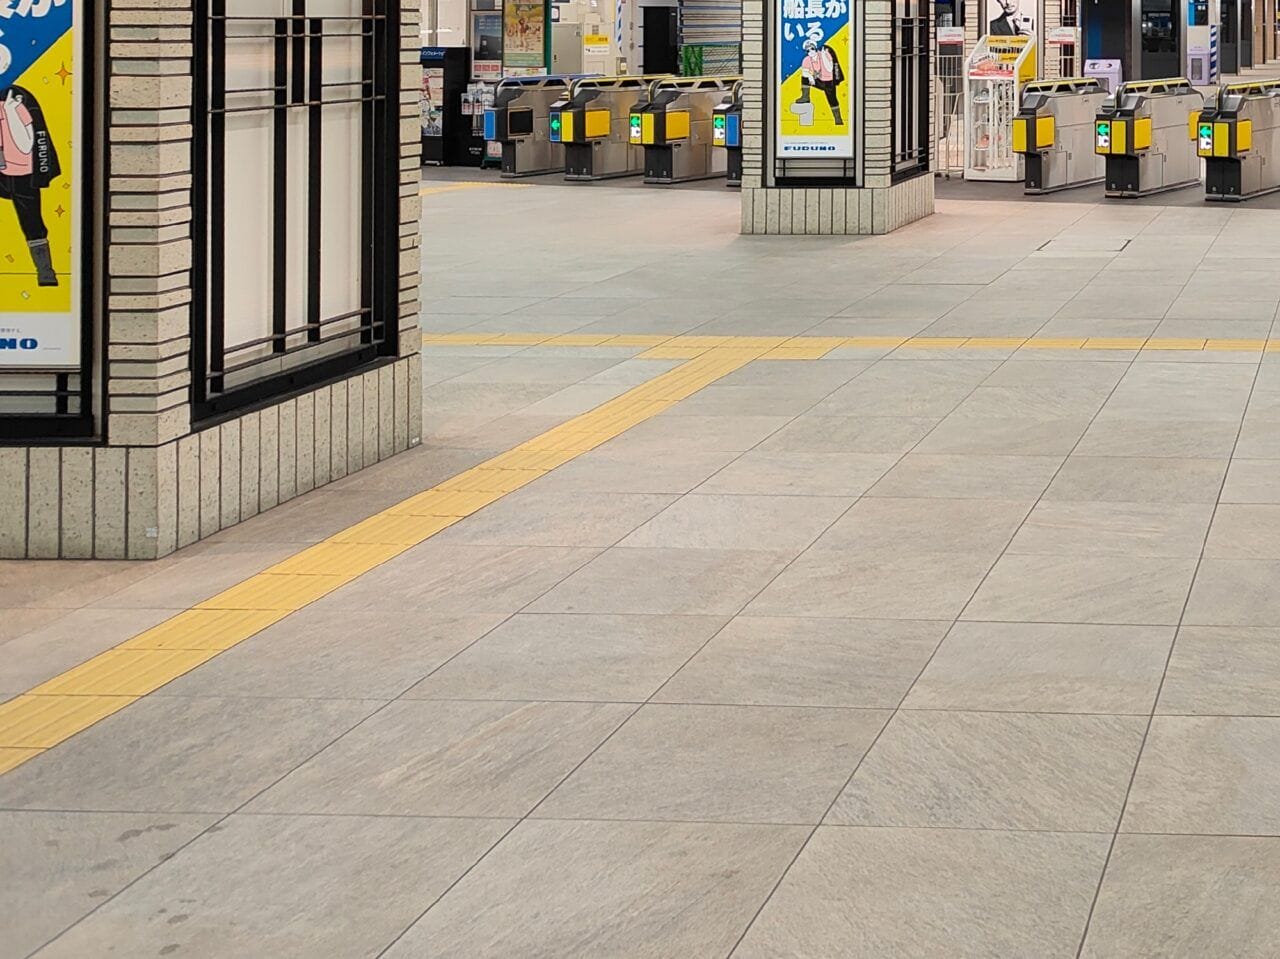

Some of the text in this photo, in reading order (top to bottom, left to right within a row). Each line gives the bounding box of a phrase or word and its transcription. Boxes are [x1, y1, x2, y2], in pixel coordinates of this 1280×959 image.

[784, 21, 825, 43] いる
[1097, 135, 1109, 147] IC
[1200, 137, 1212, 150] IC
[36, 130, 49, 174] FURUNO
